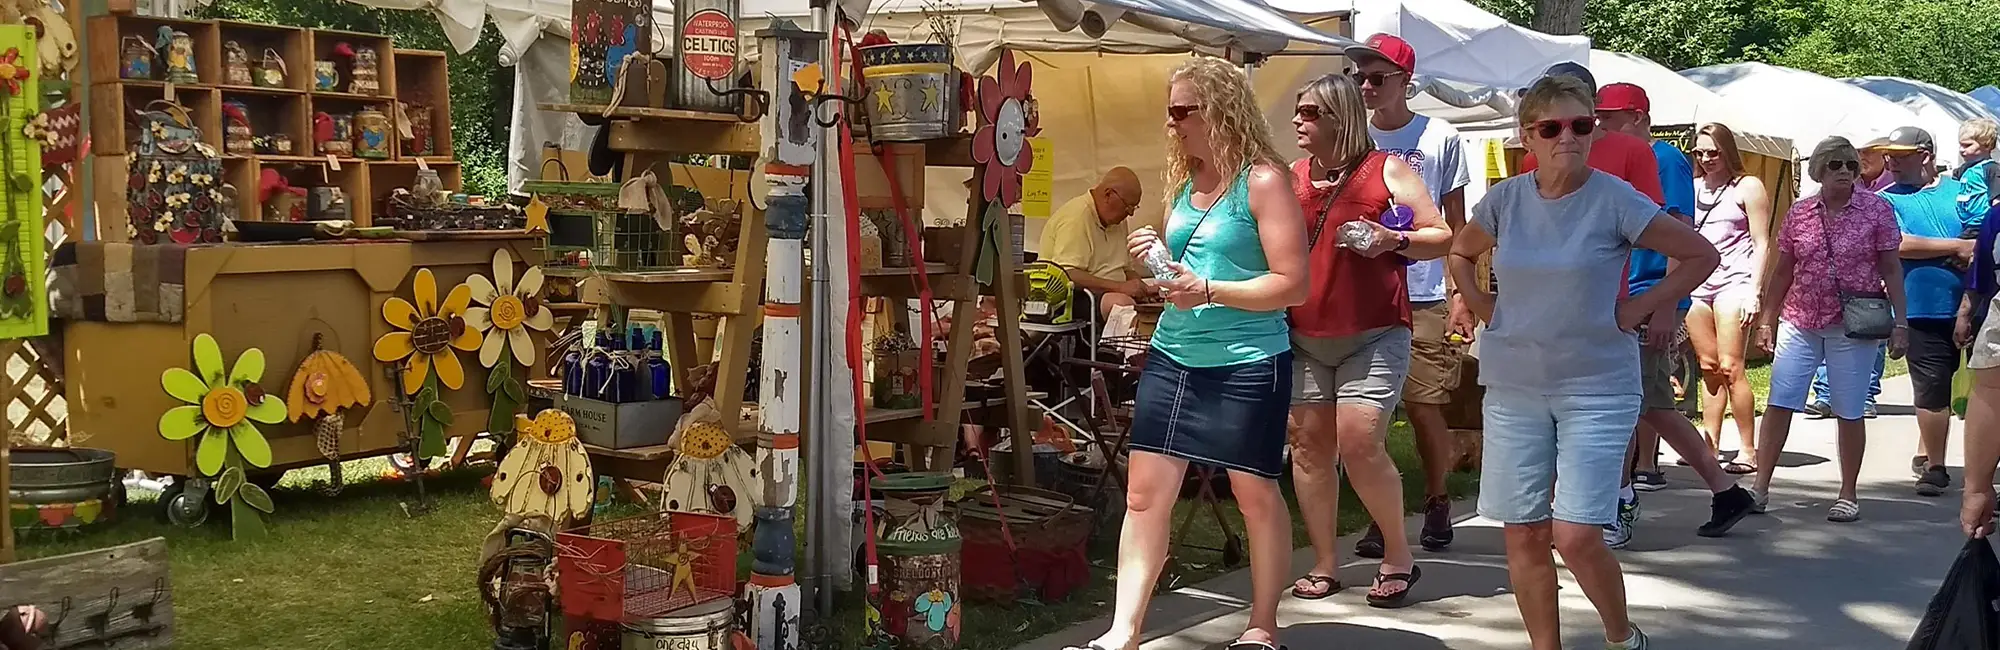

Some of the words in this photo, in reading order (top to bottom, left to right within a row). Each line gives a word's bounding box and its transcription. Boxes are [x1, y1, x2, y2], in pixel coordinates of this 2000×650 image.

[683, 37, 735, 54] CELTICS
[561, 404, 581, 418] FARM
[583, 409, 607, 423] HOUSE
[656, 639, 675, 650] one
